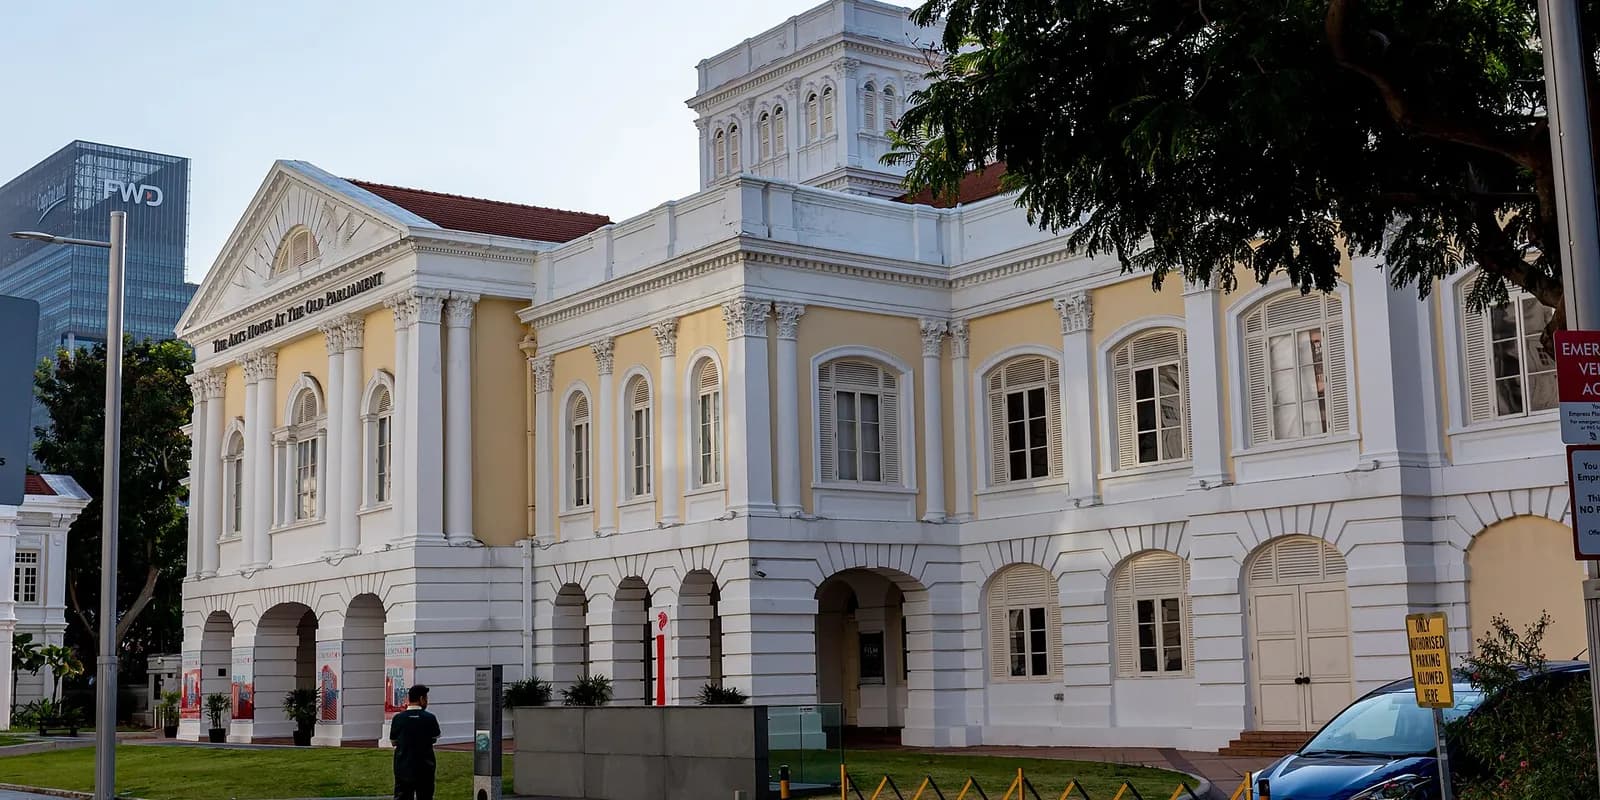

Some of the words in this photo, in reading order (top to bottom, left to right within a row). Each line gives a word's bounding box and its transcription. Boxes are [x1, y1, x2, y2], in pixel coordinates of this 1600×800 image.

[104, 180, 163, 207] FWD
[326, 271, 383, 306] PARLIAMENT
[1583, 462, 1598, 470] You
[1580, 506, 1594, 514] NO
[1416, 617, 1431, 633] ONLY
[1410, 635, 1445, 651] AUTHORISED
[1415, 653, 1441, 668] PARKING
[1417, 671, 1445, 686] ALLOWED
[1424, 688, 1439, 703] HERE
